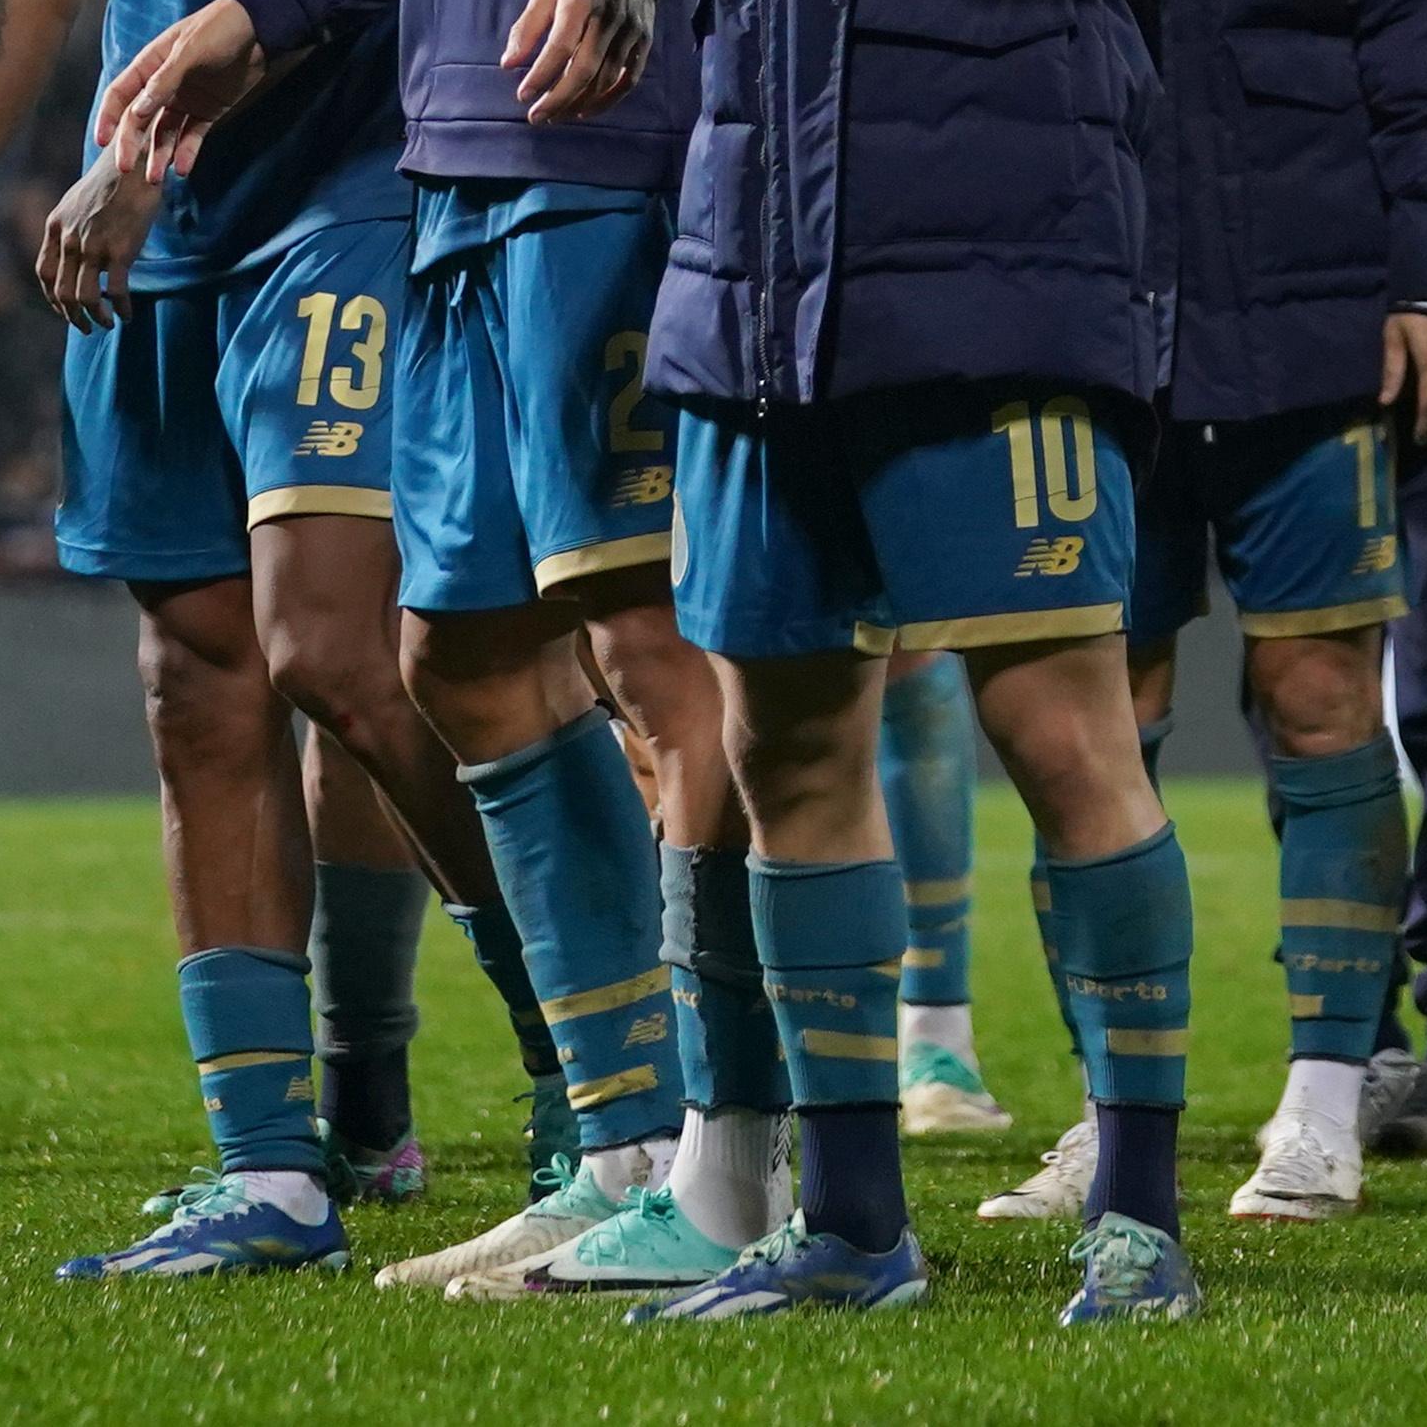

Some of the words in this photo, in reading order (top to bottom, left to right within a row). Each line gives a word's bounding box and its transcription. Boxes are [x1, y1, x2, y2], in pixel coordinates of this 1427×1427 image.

[296, 291, 387, 411] 13
[604, 330, 665, 453] 2
[991, 394, 1099, 529] 10
